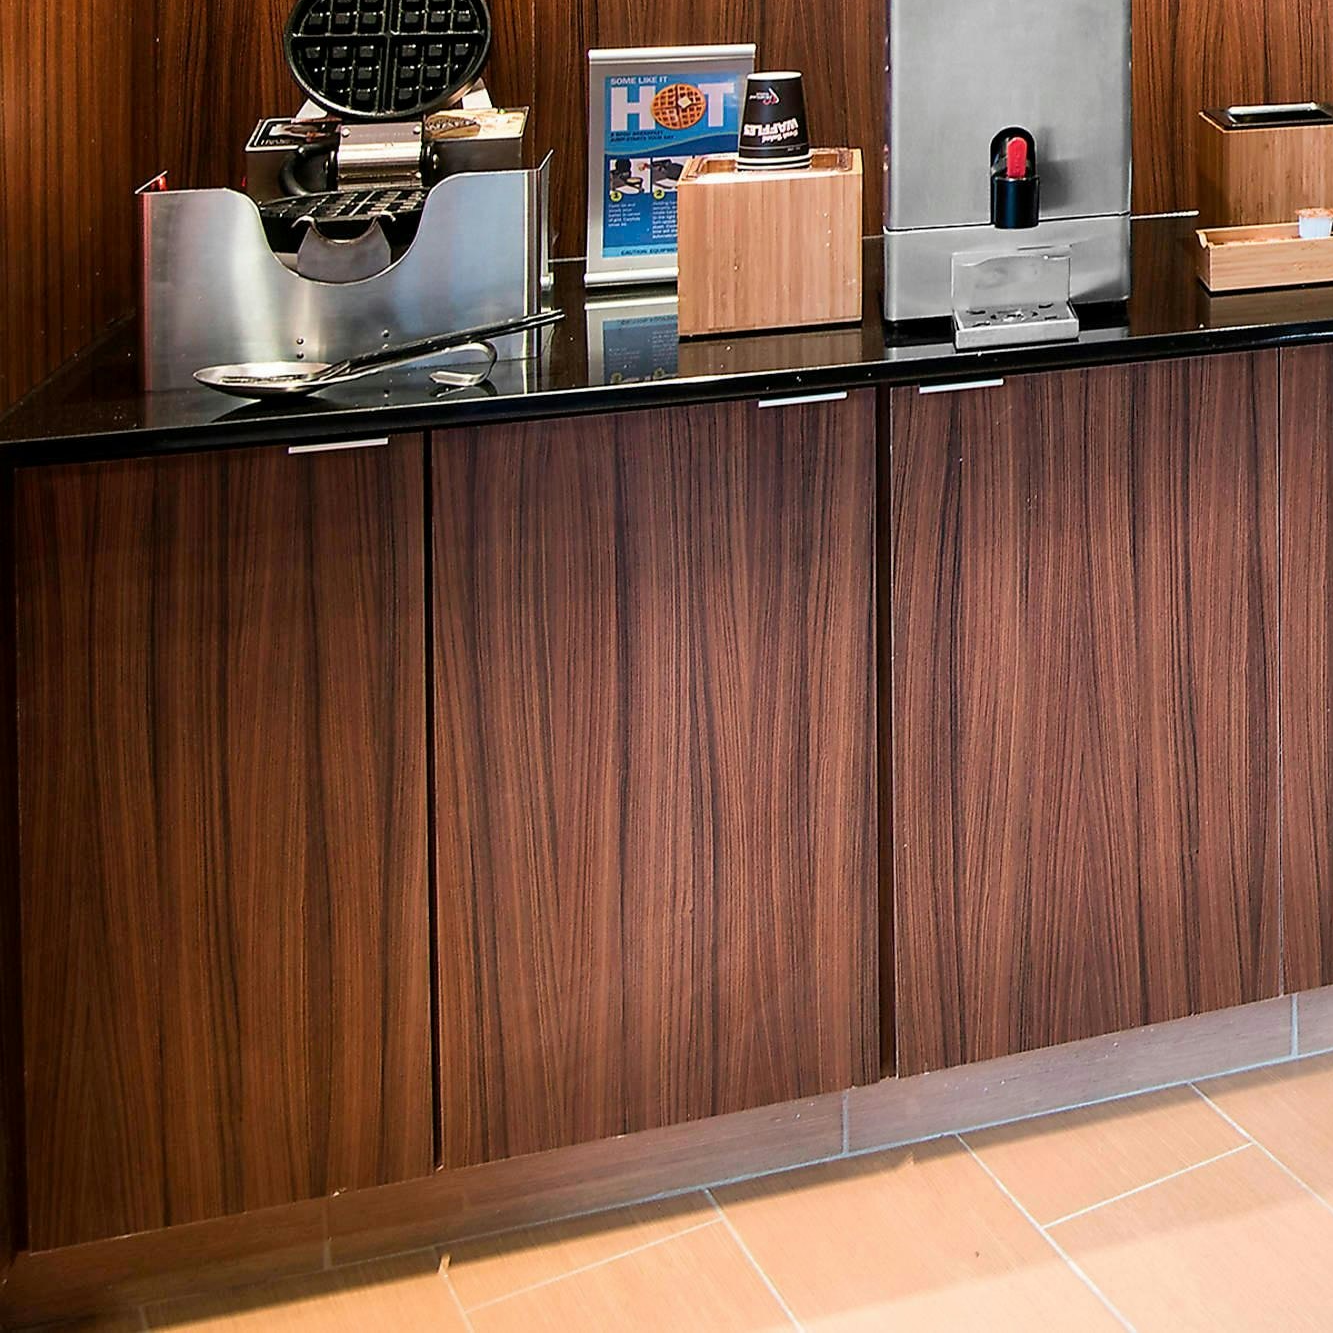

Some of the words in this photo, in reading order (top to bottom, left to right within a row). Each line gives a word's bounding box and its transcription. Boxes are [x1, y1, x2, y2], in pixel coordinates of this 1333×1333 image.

[610, 76, 637, 85] SOME
[638, 76, 657, 84] LIKE
[659, 75, 668, 83] IT
[611, 82, 734, 132] HOT
[743, 118, 799, 137] WAFFLES
